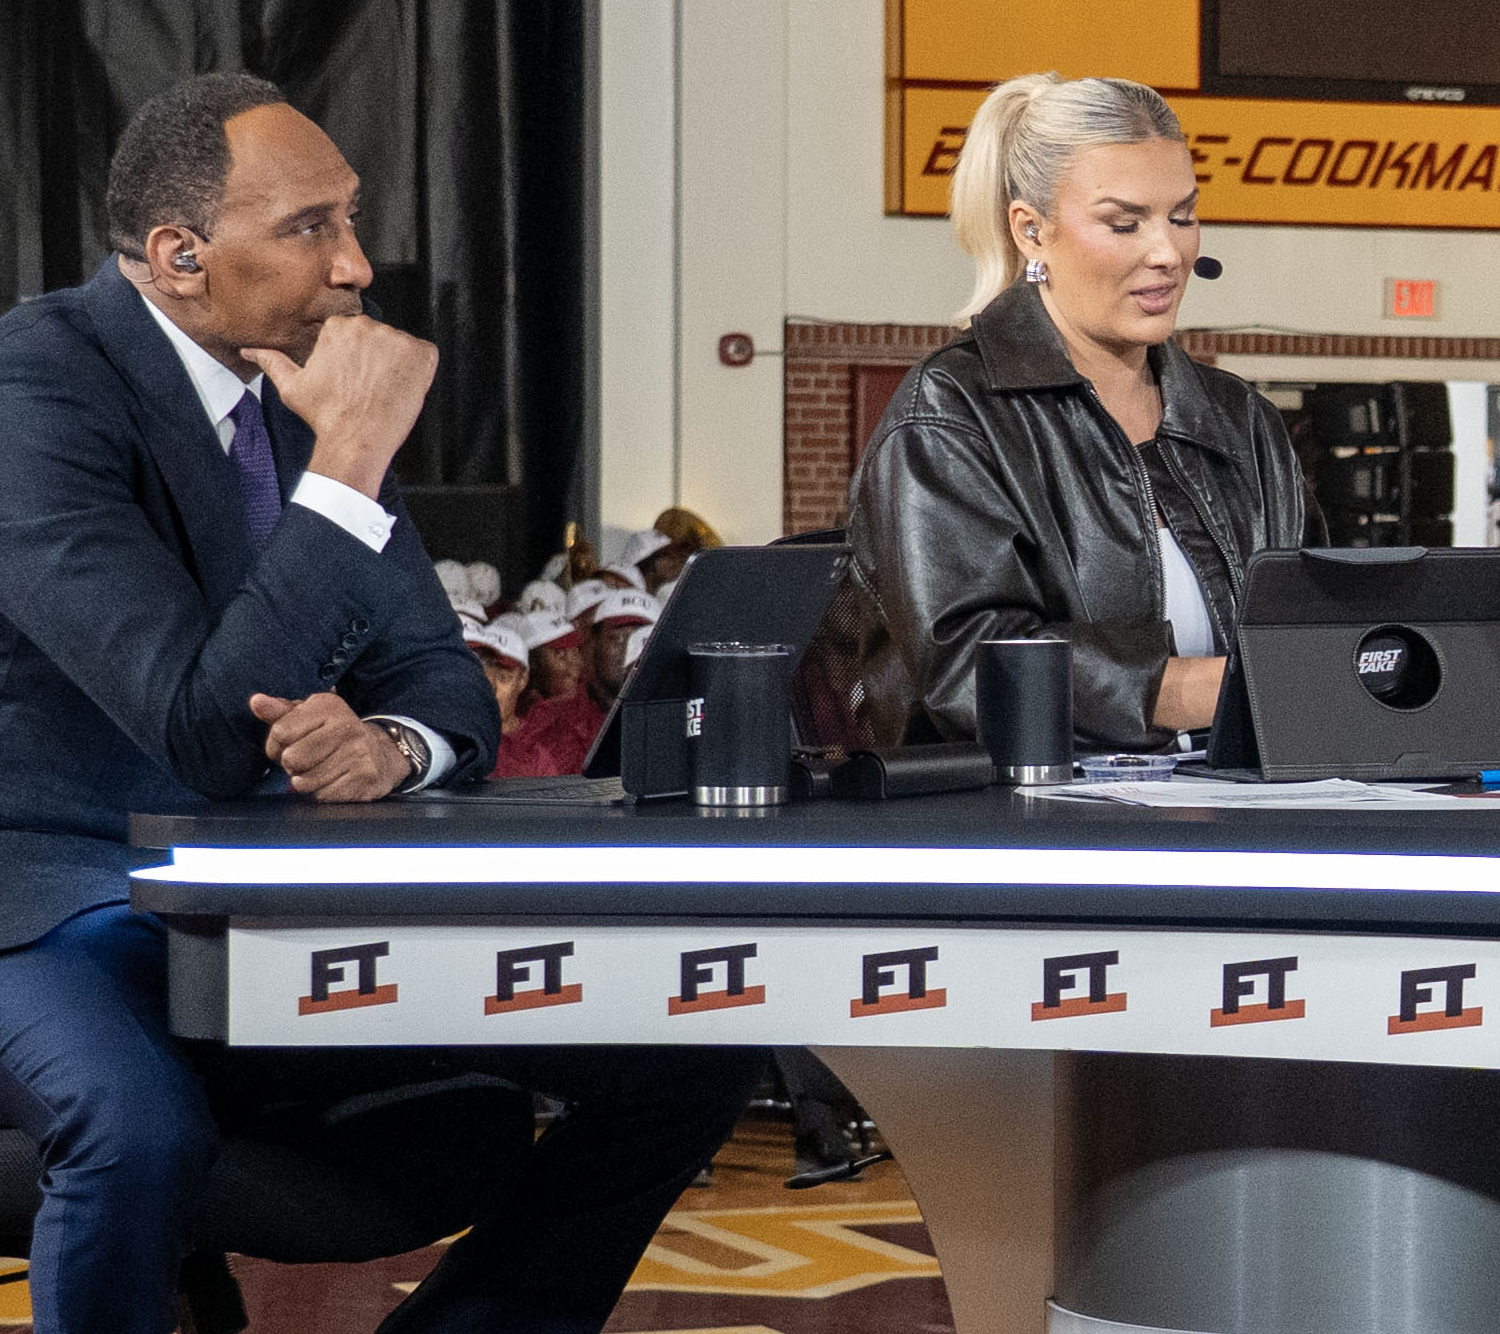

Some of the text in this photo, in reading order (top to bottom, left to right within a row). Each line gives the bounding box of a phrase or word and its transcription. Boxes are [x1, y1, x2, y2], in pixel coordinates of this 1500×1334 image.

[1358, 660, 1397, 674] TAKE
[1359, 648, 1403, 664] FIRST
[310, 941, 390, 1002] FT
[495, 941, 575, 1002] FT
[679, 942, 758, 1003] FT
[861, 946, 939, 1005] FT
[1042, 949, 1120, 1009] FT
[1222, 954, 1299, 1015] FT
[1399, 962, 1477, 1022] FT
